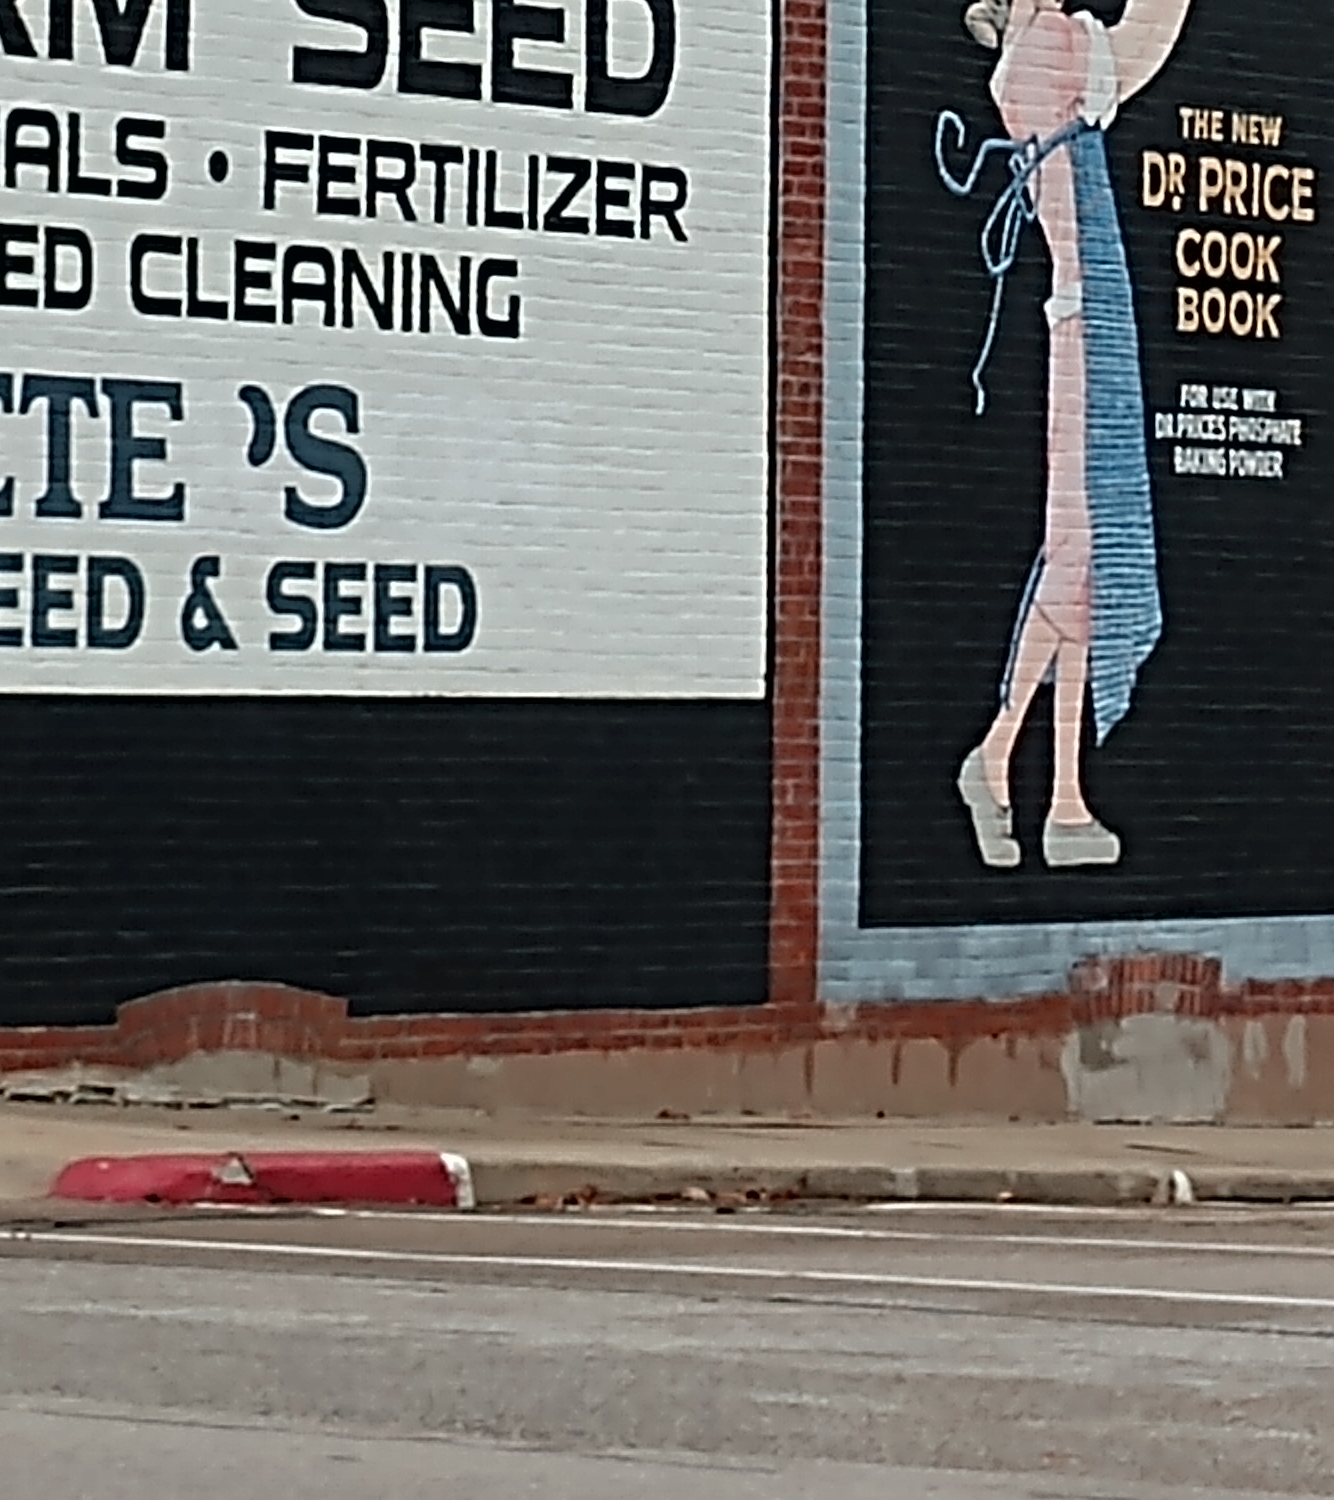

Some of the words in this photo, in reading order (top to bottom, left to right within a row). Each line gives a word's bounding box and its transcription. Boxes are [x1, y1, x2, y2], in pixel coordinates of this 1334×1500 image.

[1178, 107, 1223, 142] THE
[1232, 112, 1283, 147] NEW
[264, 130, 688, 242] FERTILIZER
[1199, 156, 1315, 222] PRICE
[130, 233, 520, 338] CLEANING
[1176, 228, 1282, 283] COOK
[1176, 286, 1282, 339] BOOK
[181, 556, 238, 651] &
[267, 562, 477, 653] SEED
